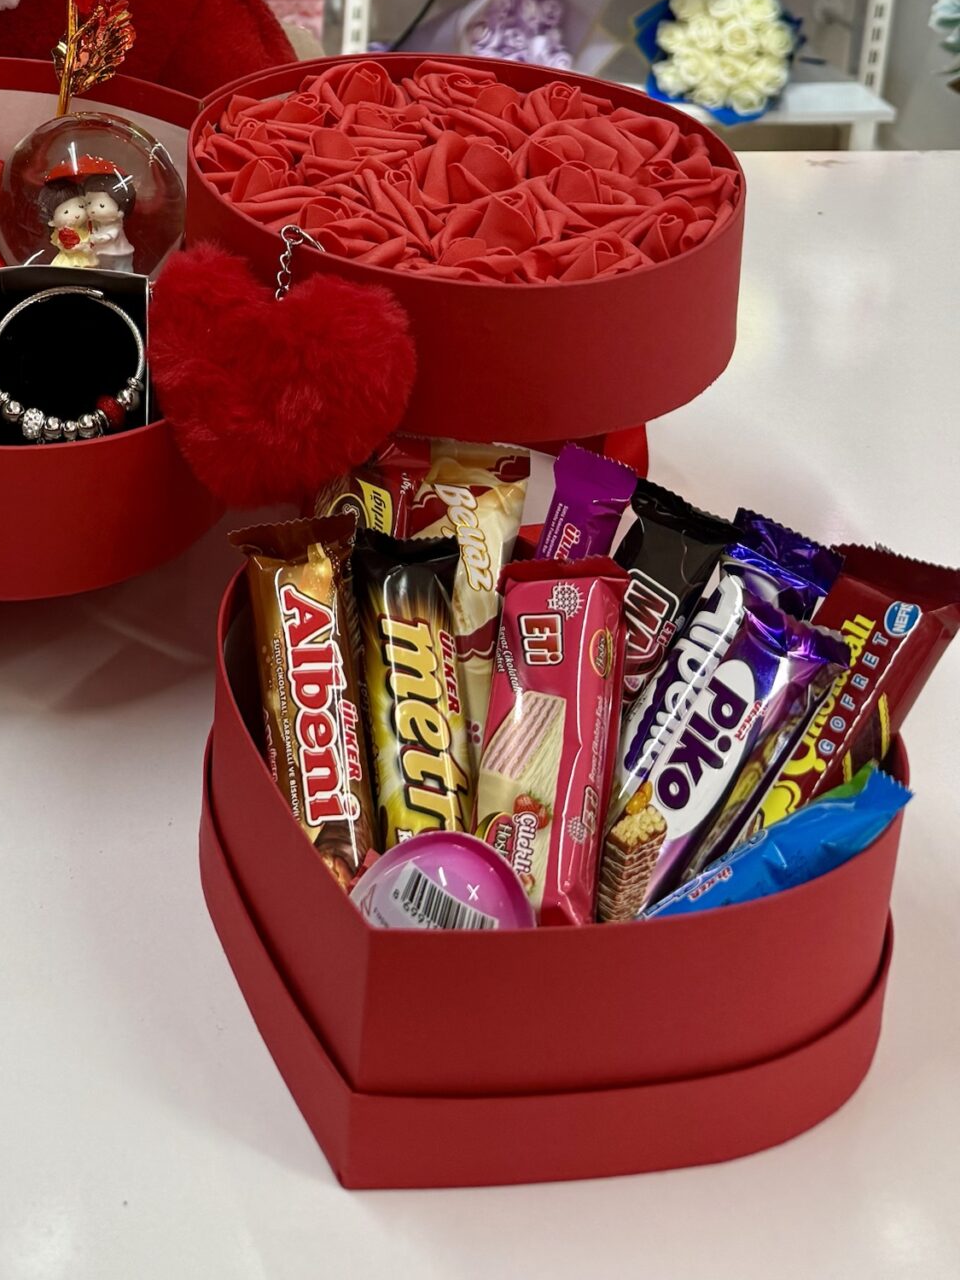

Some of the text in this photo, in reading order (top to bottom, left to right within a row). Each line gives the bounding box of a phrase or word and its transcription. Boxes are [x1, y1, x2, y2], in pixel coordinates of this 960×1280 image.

[431, 483, 494, 592] Beyaz
[281, 584, 361, 827] Albeni
[438, 629, 461, 714] ÜLKER
[818, 633, 889, 756] GOFRET
[338, 700, 362, 782] ÜLKER
[512, 811, 538, 874] Çilekli
